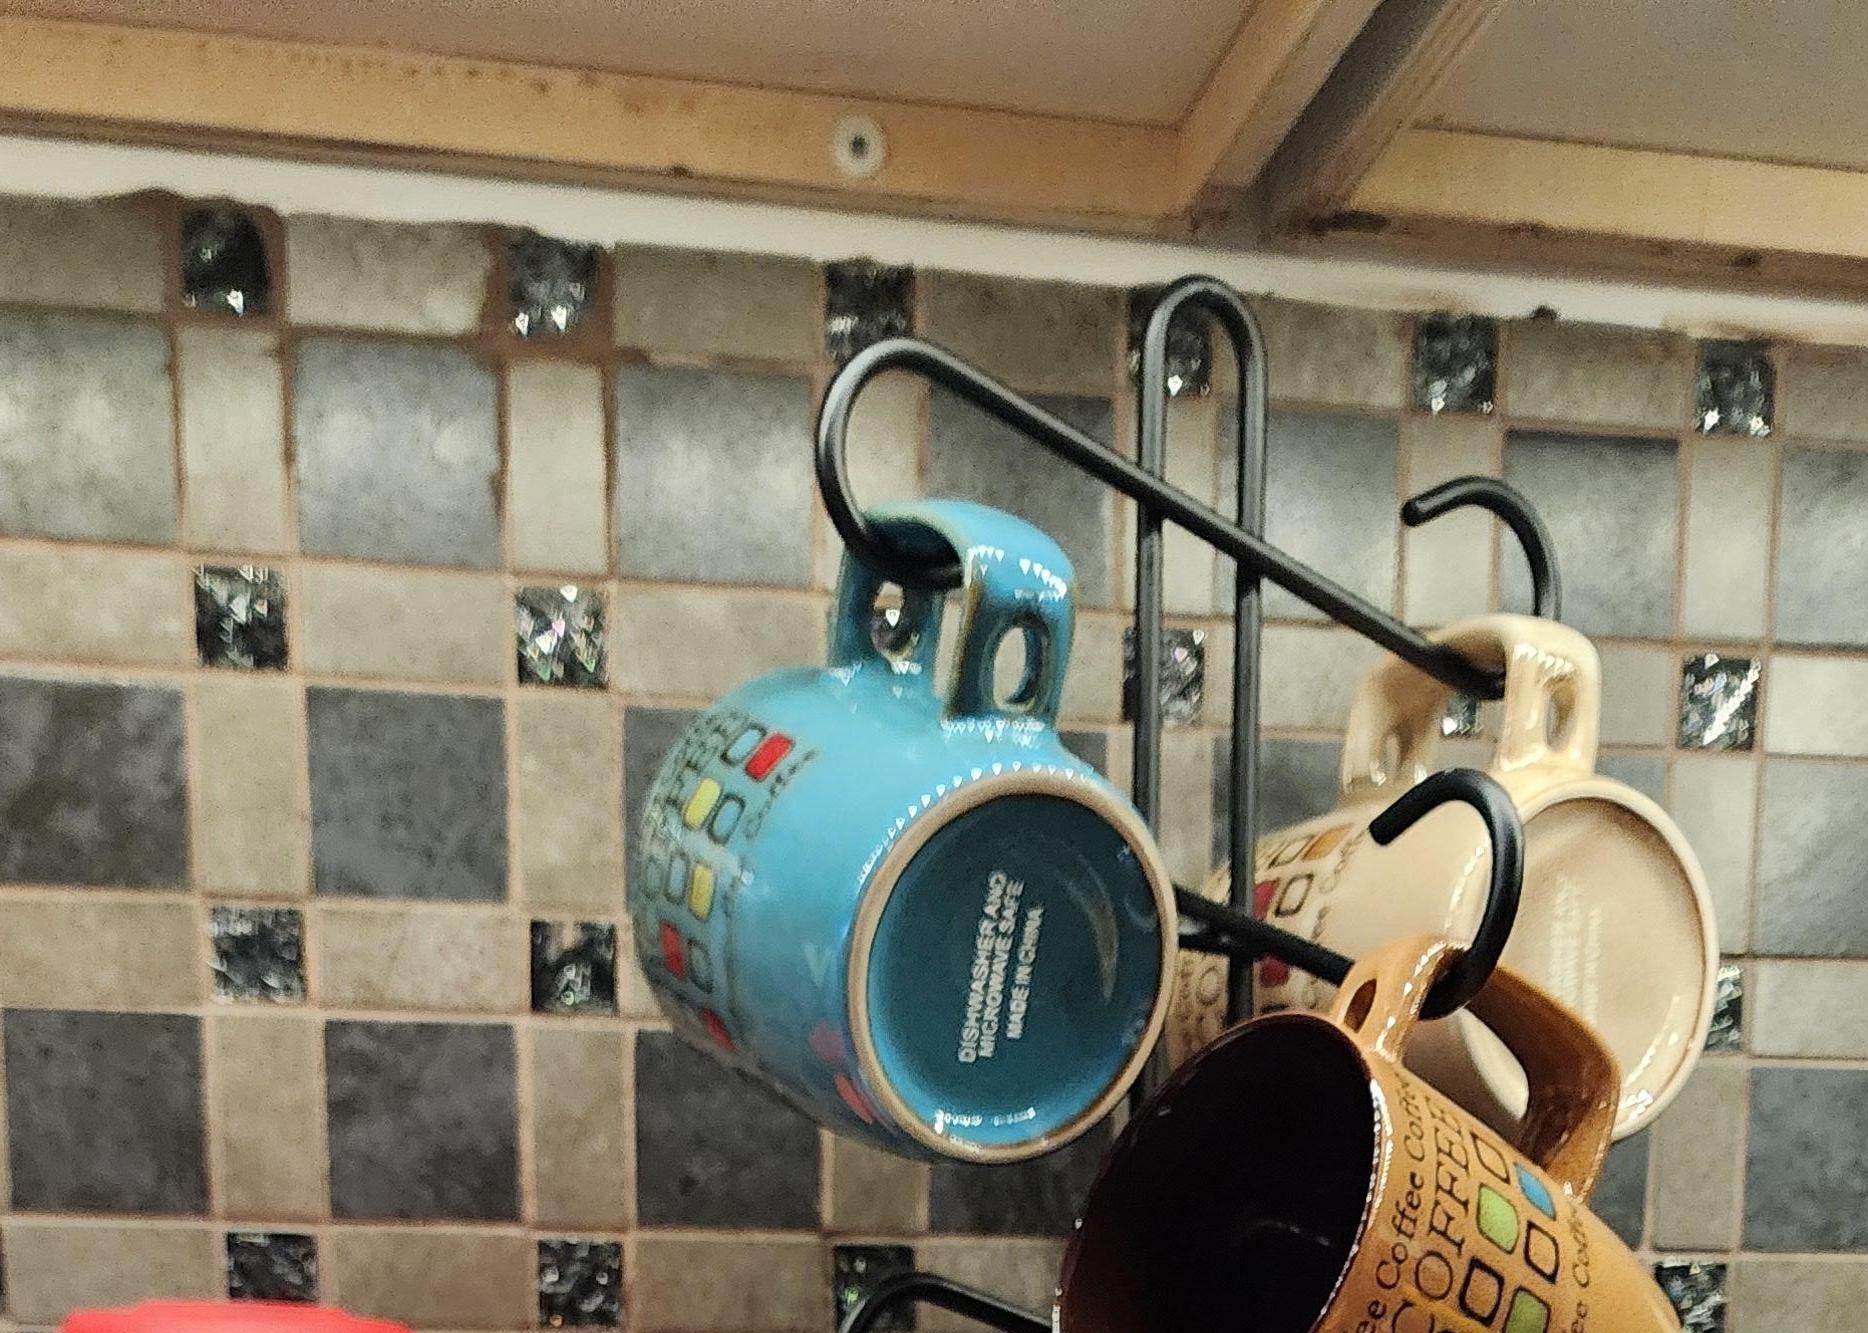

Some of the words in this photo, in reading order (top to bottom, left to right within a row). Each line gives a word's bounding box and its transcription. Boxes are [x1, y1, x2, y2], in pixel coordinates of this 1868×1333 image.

[957, 918, 998, 1063] DISHWASHER
[978, 935, 1014, 1058] MICROWAVE
[998, 879, 1026, 934] SAFE
[1018, 904, 1045, 963] CHINA
[1006, 985, 1031, 1040] MADE
[1376, 1171, 1425, 1290] Coffee
